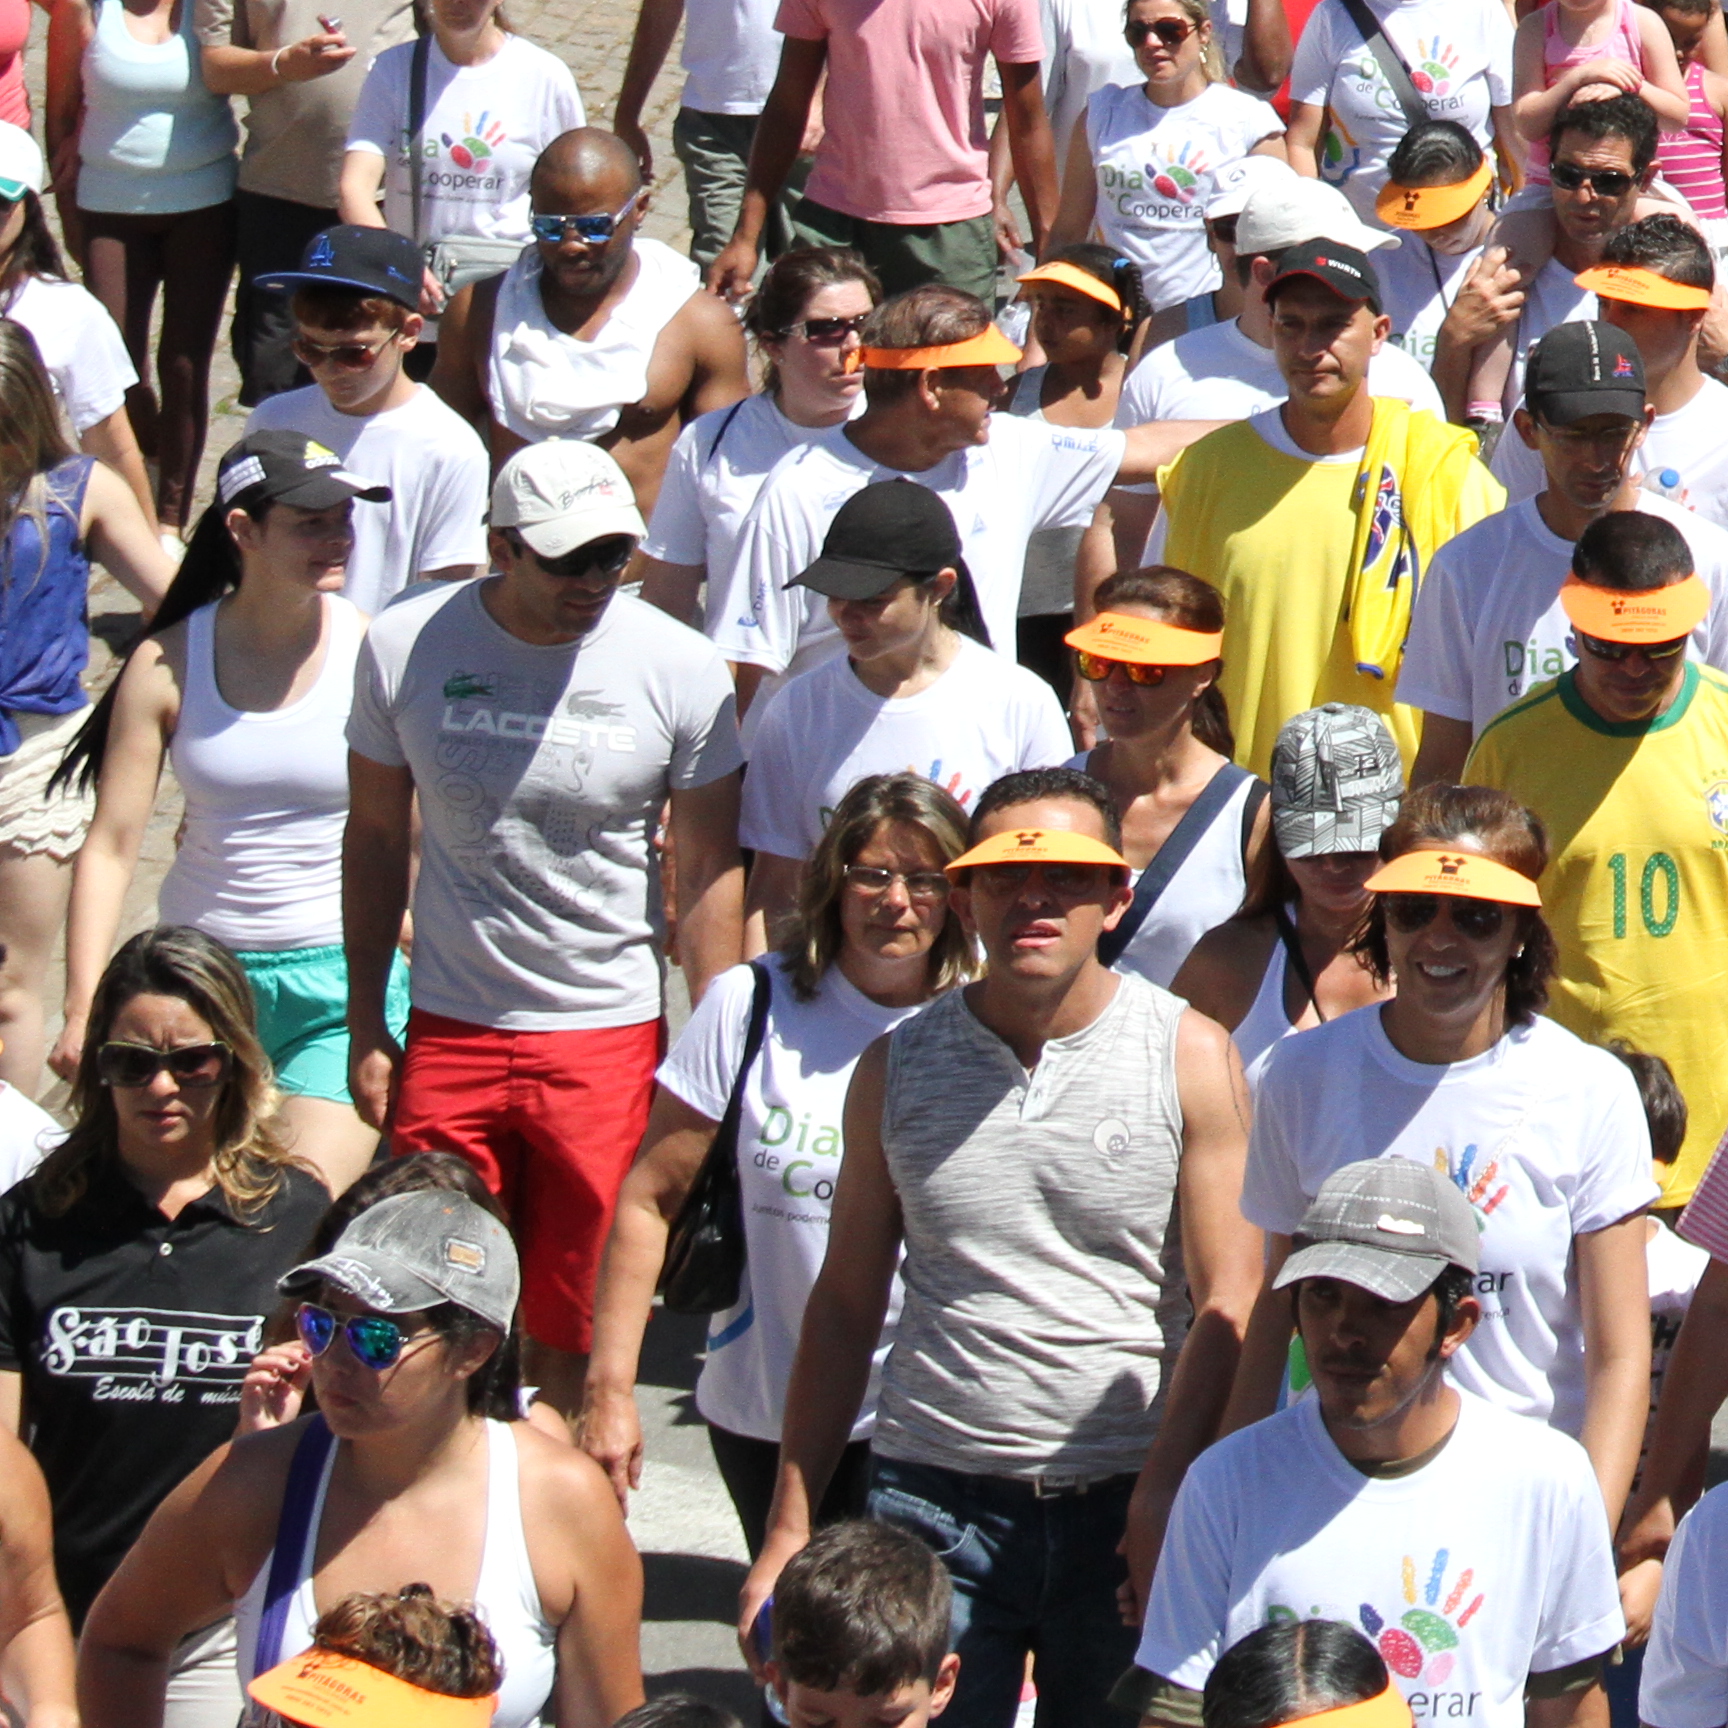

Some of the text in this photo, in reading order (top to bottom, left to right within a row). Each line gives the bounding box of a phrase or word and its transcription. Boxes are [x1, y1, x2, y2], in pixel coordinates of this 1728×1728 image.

[428, 171, 504, 195] ooperar
[1118, 193, 1204, 221] Coopera
[1504, 638, 1566, 677] Dia
[441, 705, 638, 753] LACOSTE
[1607, 851, 1680, 940] 10
[758, 1104, 840, 1157] Dia
[752, 1149, 779, 1173] de
[44, 1306, 269, 1387] São José
[93, 1376, 157, 1403] Escola
[161, 1383, 187, 1403] de
[1408, 1687, 1483, 1718] erar
